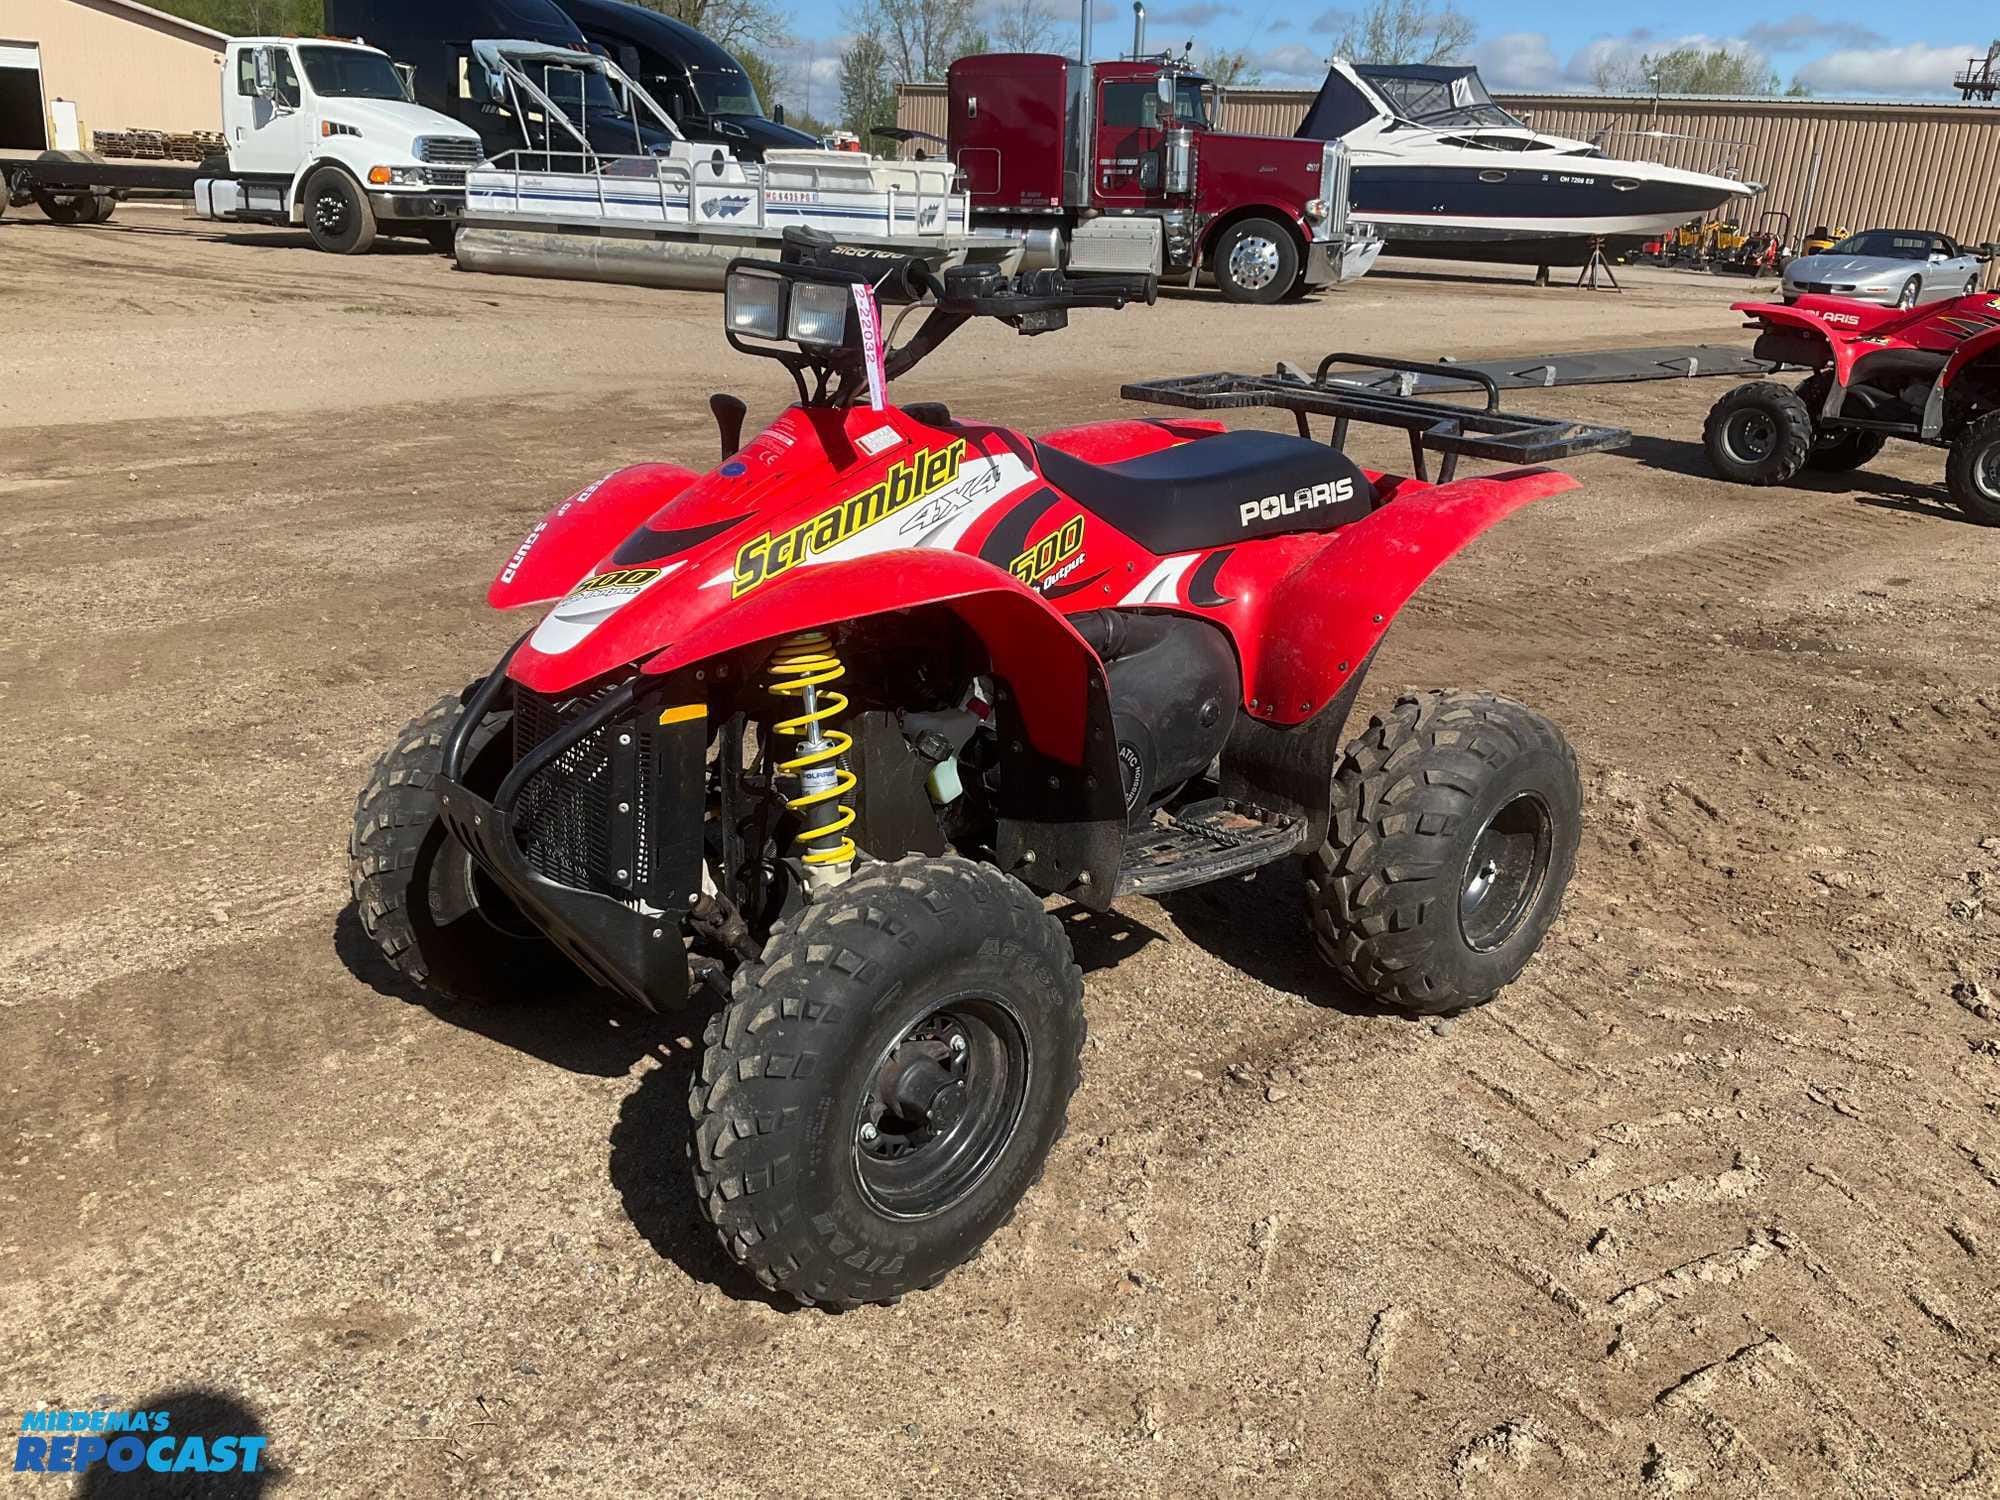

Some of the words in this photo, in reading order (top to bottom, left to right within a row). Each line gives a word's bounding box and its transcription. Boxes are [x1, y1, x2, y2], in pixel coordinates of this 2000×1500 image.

[855, 286, 876, 364] 2-22032
[1807, 310, 1860, 325] OLARIS
[730, 436, 967, 600] Scrambler
[1240, 477, 1354, 527] POLARIS
[1008, 513, 1085, 586] 500
[1043, 552, 1086, 590] Output
